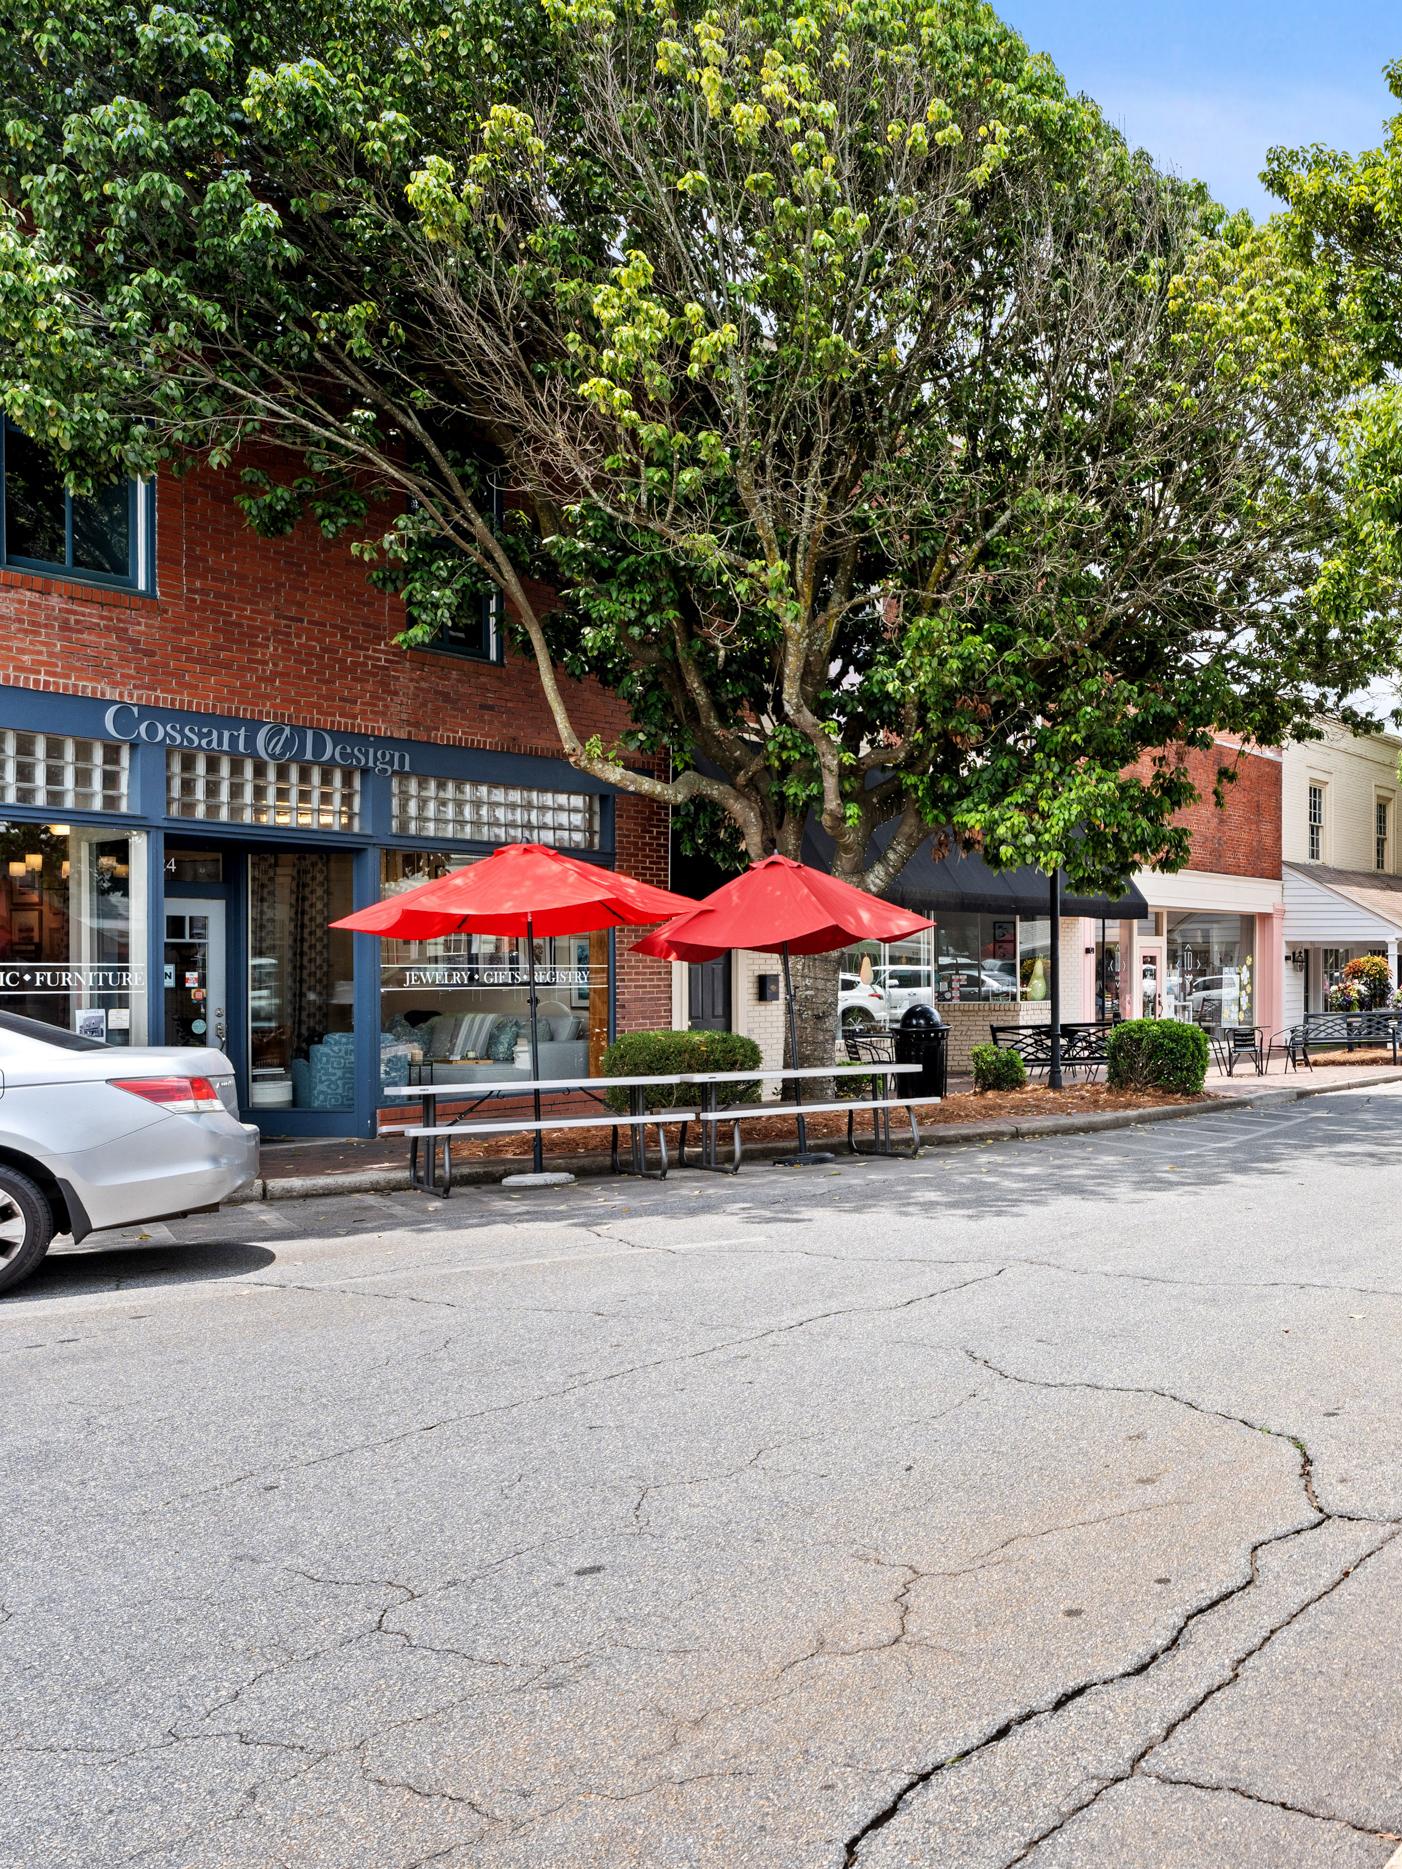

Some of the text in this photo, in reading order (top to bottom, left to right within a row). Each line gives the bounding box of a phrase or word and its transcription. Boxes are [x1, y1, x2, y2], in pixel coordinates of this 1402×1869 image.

[104, 703, 251, 754] Cossart
[303, 729, 412, 776] Design
[163, 857, 177, 873] 4
[34, 971, 144, 987] FURNITURE
[404, 971, 471, 987] JEWELRY
[483, 970, 521, 984] GIFTS
